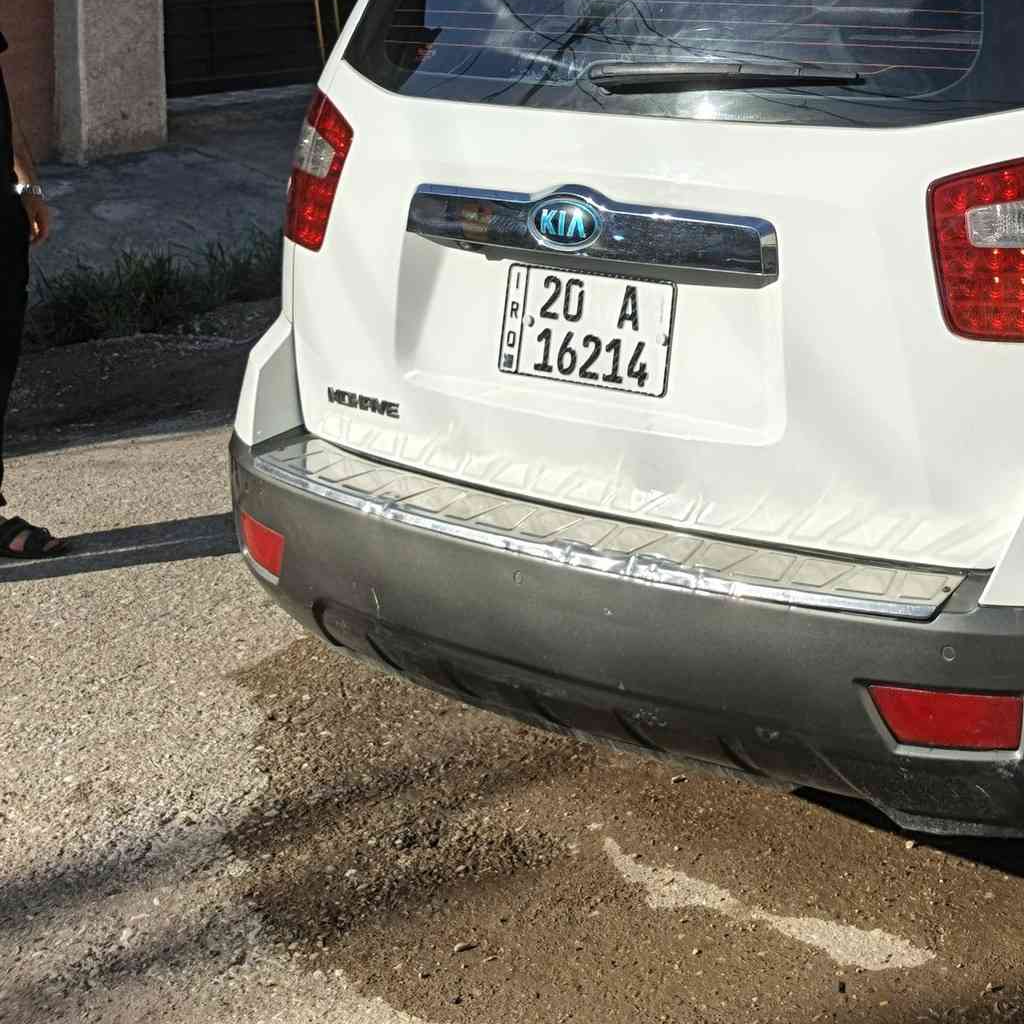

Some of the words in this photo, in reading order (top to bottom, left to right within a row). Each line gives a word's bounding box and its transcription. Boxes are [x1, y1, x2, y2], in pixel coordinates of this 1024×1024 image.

[540, 207, 586, 239] KIA
[539, 275, 585, 323] 20
[616, 284, 640, 332] A
[532, 327, 648, 388] 16214
